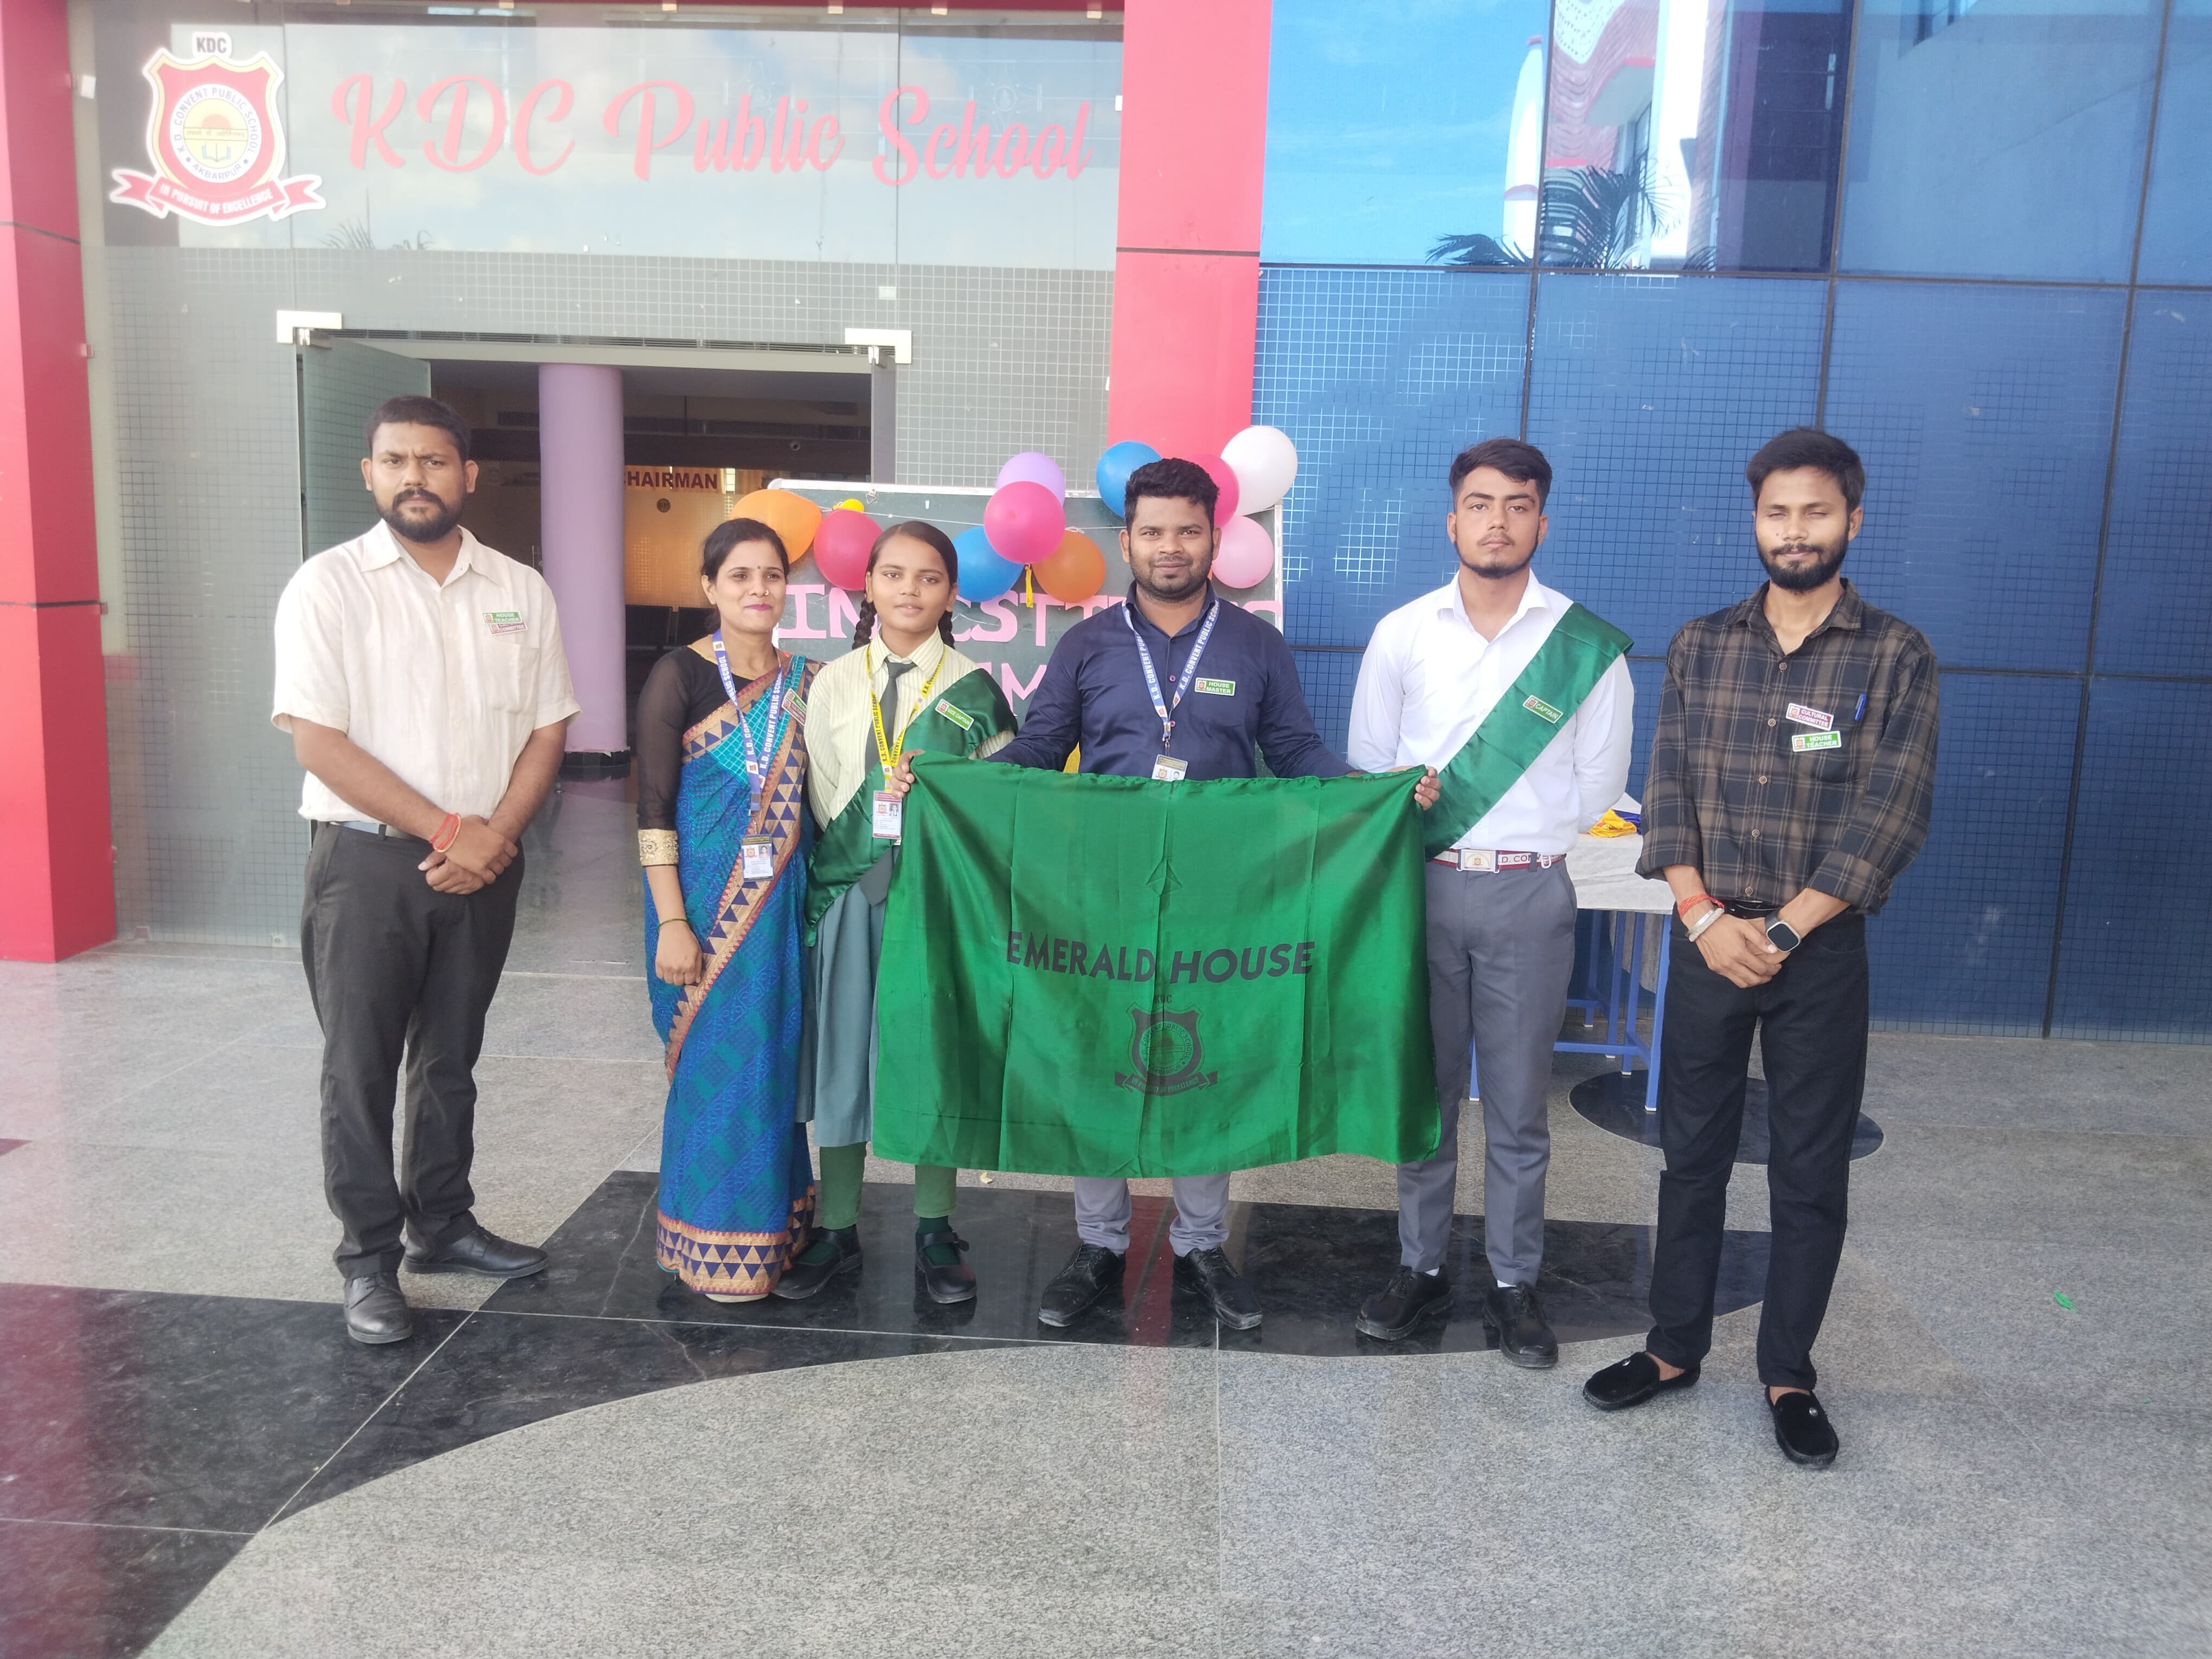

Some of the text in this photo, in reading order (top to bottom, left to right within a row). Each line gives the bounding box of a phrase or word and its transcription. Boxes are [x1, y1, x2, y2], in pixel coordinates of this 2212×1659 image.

[196, 37, 227, 53] KDC
[174, 88, 208, 126] CONVENT
[212, 87, 247, 110] PUBLIC
[245, 111, 259, 153] SCHOOL
[331, 73, 1093, 187] KDC Public School
[192, 163, 242, 180] AKBARPUR
[160, 183, 273, 214] IN PURSUIT OF EXCELLENCE
[625, 471, 718, 489] HAIRMAN
[1185, 644, 1203, 674] CONVENT
[1197, 621, 1212, 645] PUBLIC
[718, 655, 730, 680] SCHOOL
[1141, 652, 1156, 683] CONVENT
[764, 719, 776, 752] CONVENT
[770, 695, 779, 719] PUBLIC
[1535, 703, 1559, 719] CAPTAIN
[1798, 715, 1829, 728] COMMITTEE
[1801, 709, 1828, 721] CULTURAL
[876, 729, 885, 751] CONVENT
[1006, 930, 1315, 984] EMERALD HOUSE
